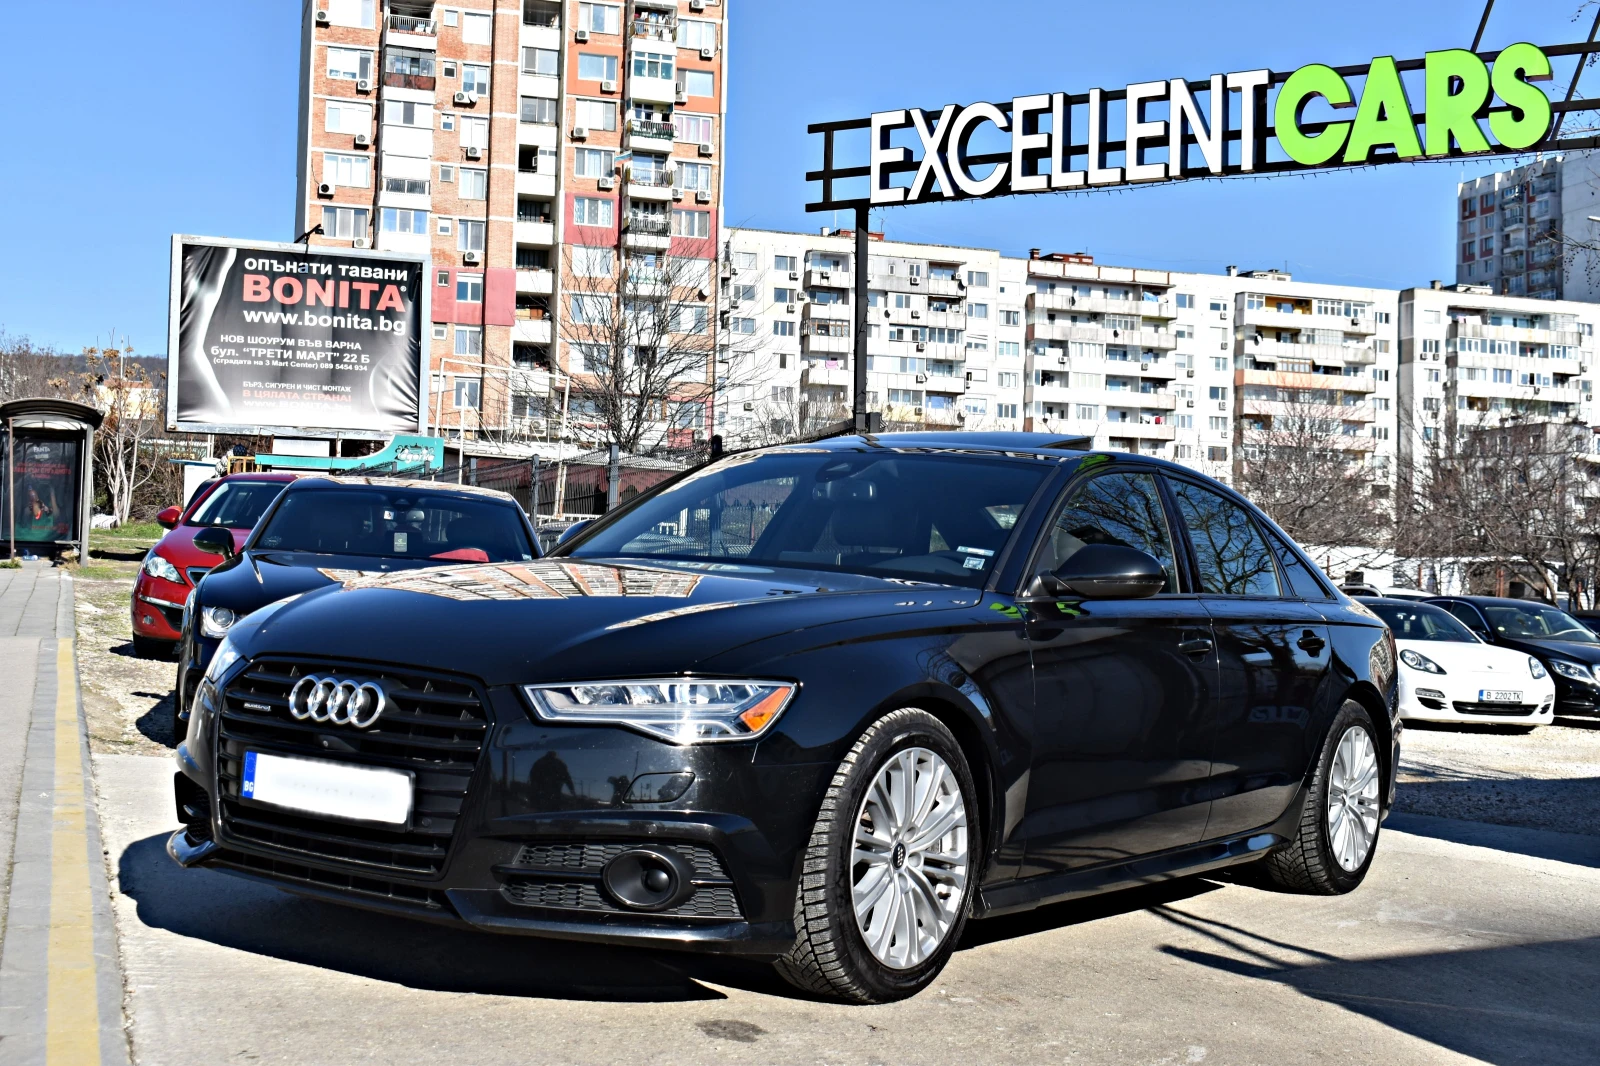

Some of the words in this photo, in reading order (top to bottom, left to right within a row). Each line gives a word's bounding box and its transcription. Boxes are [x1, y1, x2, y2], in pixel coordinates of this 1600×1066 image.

[870, 69, 1271, 205] EXCELLENT
[1274, 42, 1553, 167] CARS
[244, 258, 333, 275] опънати
[338, 264, 408, 281] тавани
[243, 310, 407, 335] www.bonita.bg
[220, 334, 245, 344] НОВ
[247, 336, 295, 346] ШОУРУМ
[298, 339, 322, 348] ВЪВ
[325, 340, 362, 350] ВАРНА
[210, 346, 239, 358] бул.
[342, 353, 358, 363] 22
[361, 354, 370, 364] Б
[271, 359, 289, 367] Mart
[290, 361, 319, 369] Center)
[243, 389, 251, 397] В
[254, 390, 300, 400] ЦЯЛАТА
[265, 382, 296, 390] СИГУРЕН
[322, 385, 352, 393] МОНТАЖ
[1494, 692, 1511, 700] 2202
[1513, 692, 1521, 700] TK
[244, 780, 254, 792] BG
